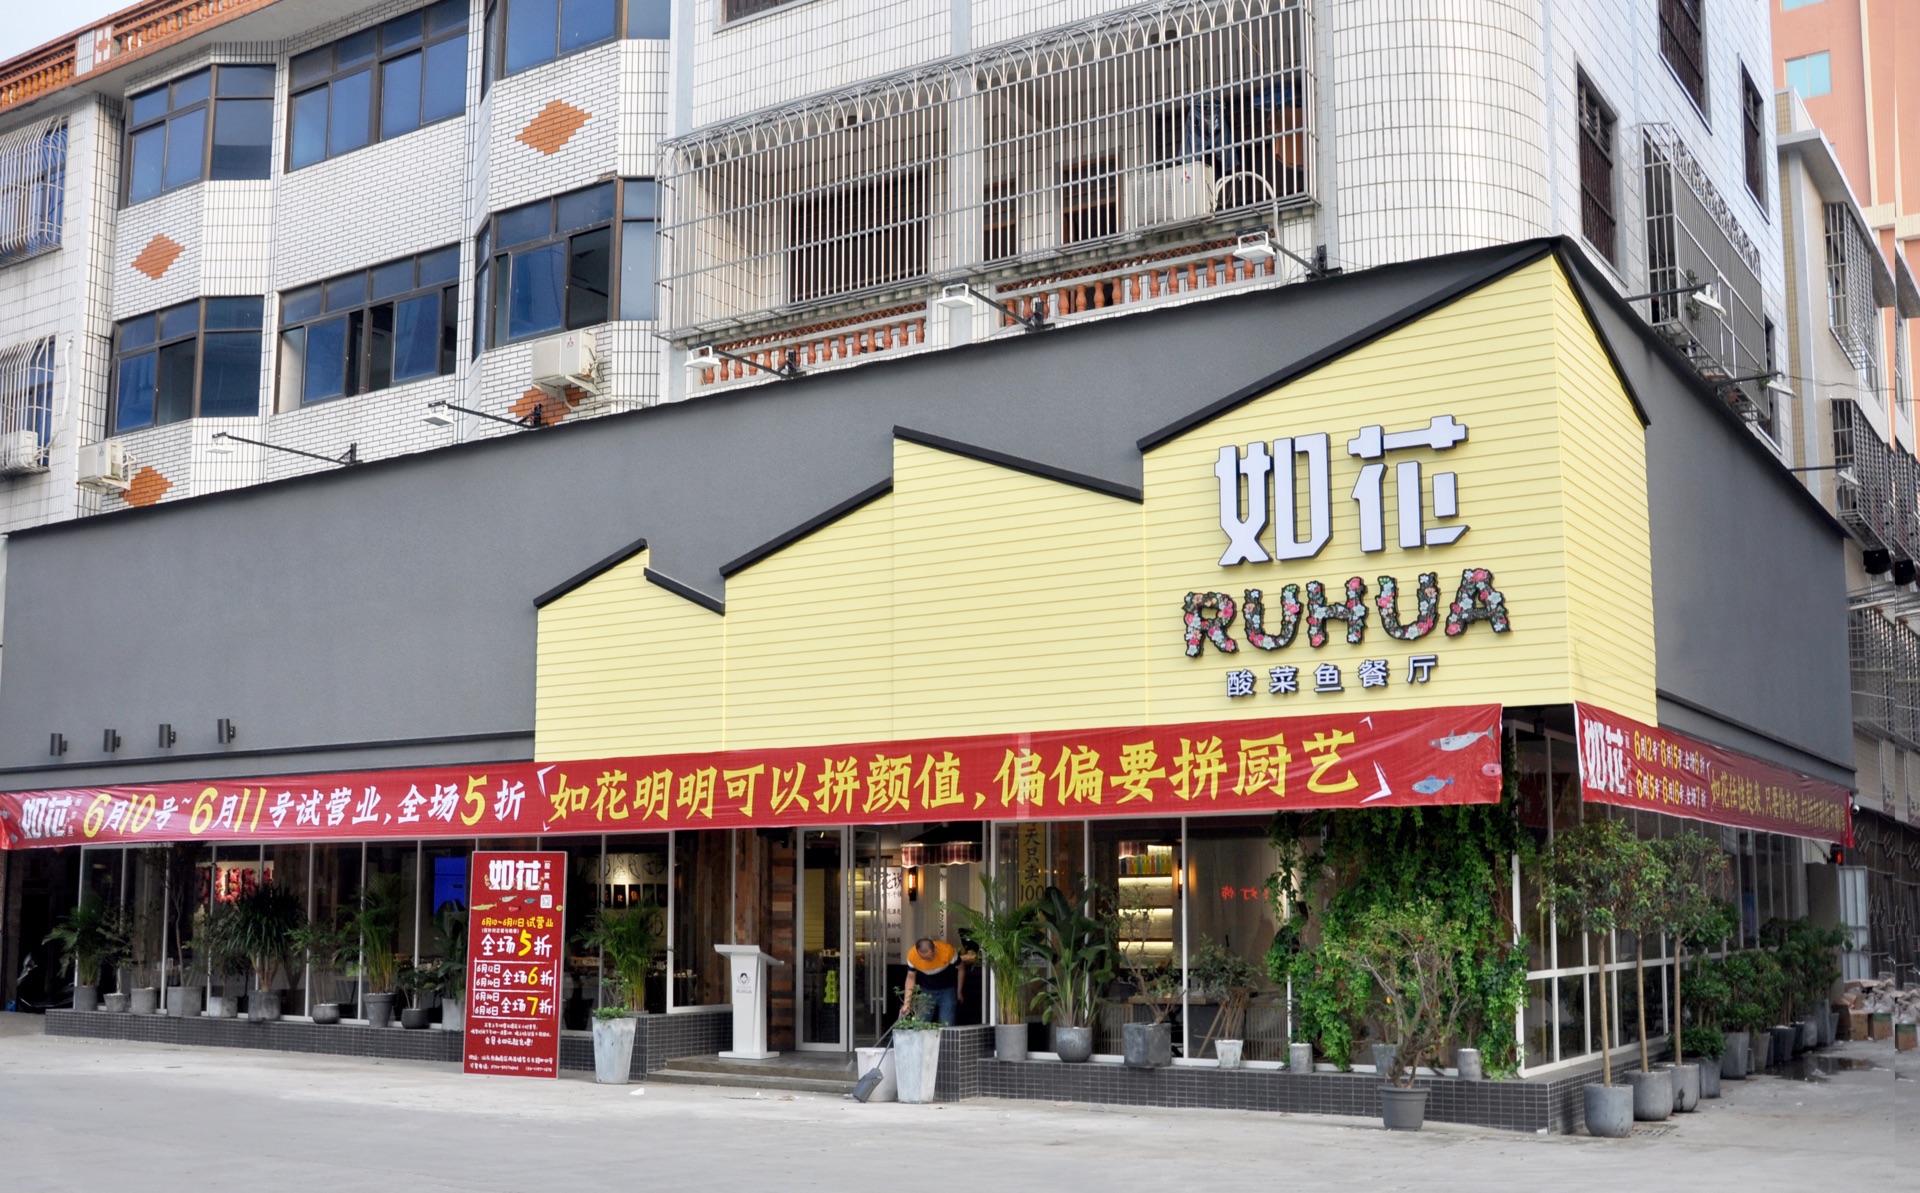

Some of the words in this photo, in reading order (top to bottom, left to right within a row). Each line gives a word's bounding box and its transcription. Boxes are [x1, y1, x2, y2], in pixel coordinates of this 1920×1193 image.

[1214, 414, 1471, 567] 如花
[1182, 568, 1513, 658] RUHUA
[1227, 654, 1438, 697] 酸菜鱼餐厅
[1583, 718, 1627, 797] 如花
[548, 730, 1359, 822] 如花明明可以拼颜值,偏偏要拼厨艺
[21, 796, 73, 839] 如花
[488, 860, 541, 890] 如花
[526, 916, 554, 929] 试营业
[481, 929, 552, 957] 全场5折
[477, 964, 501, 973] 6月12日
[502, 966, 554, 987] 全场6折
[501, 996, 553, 1016] 全场7折
